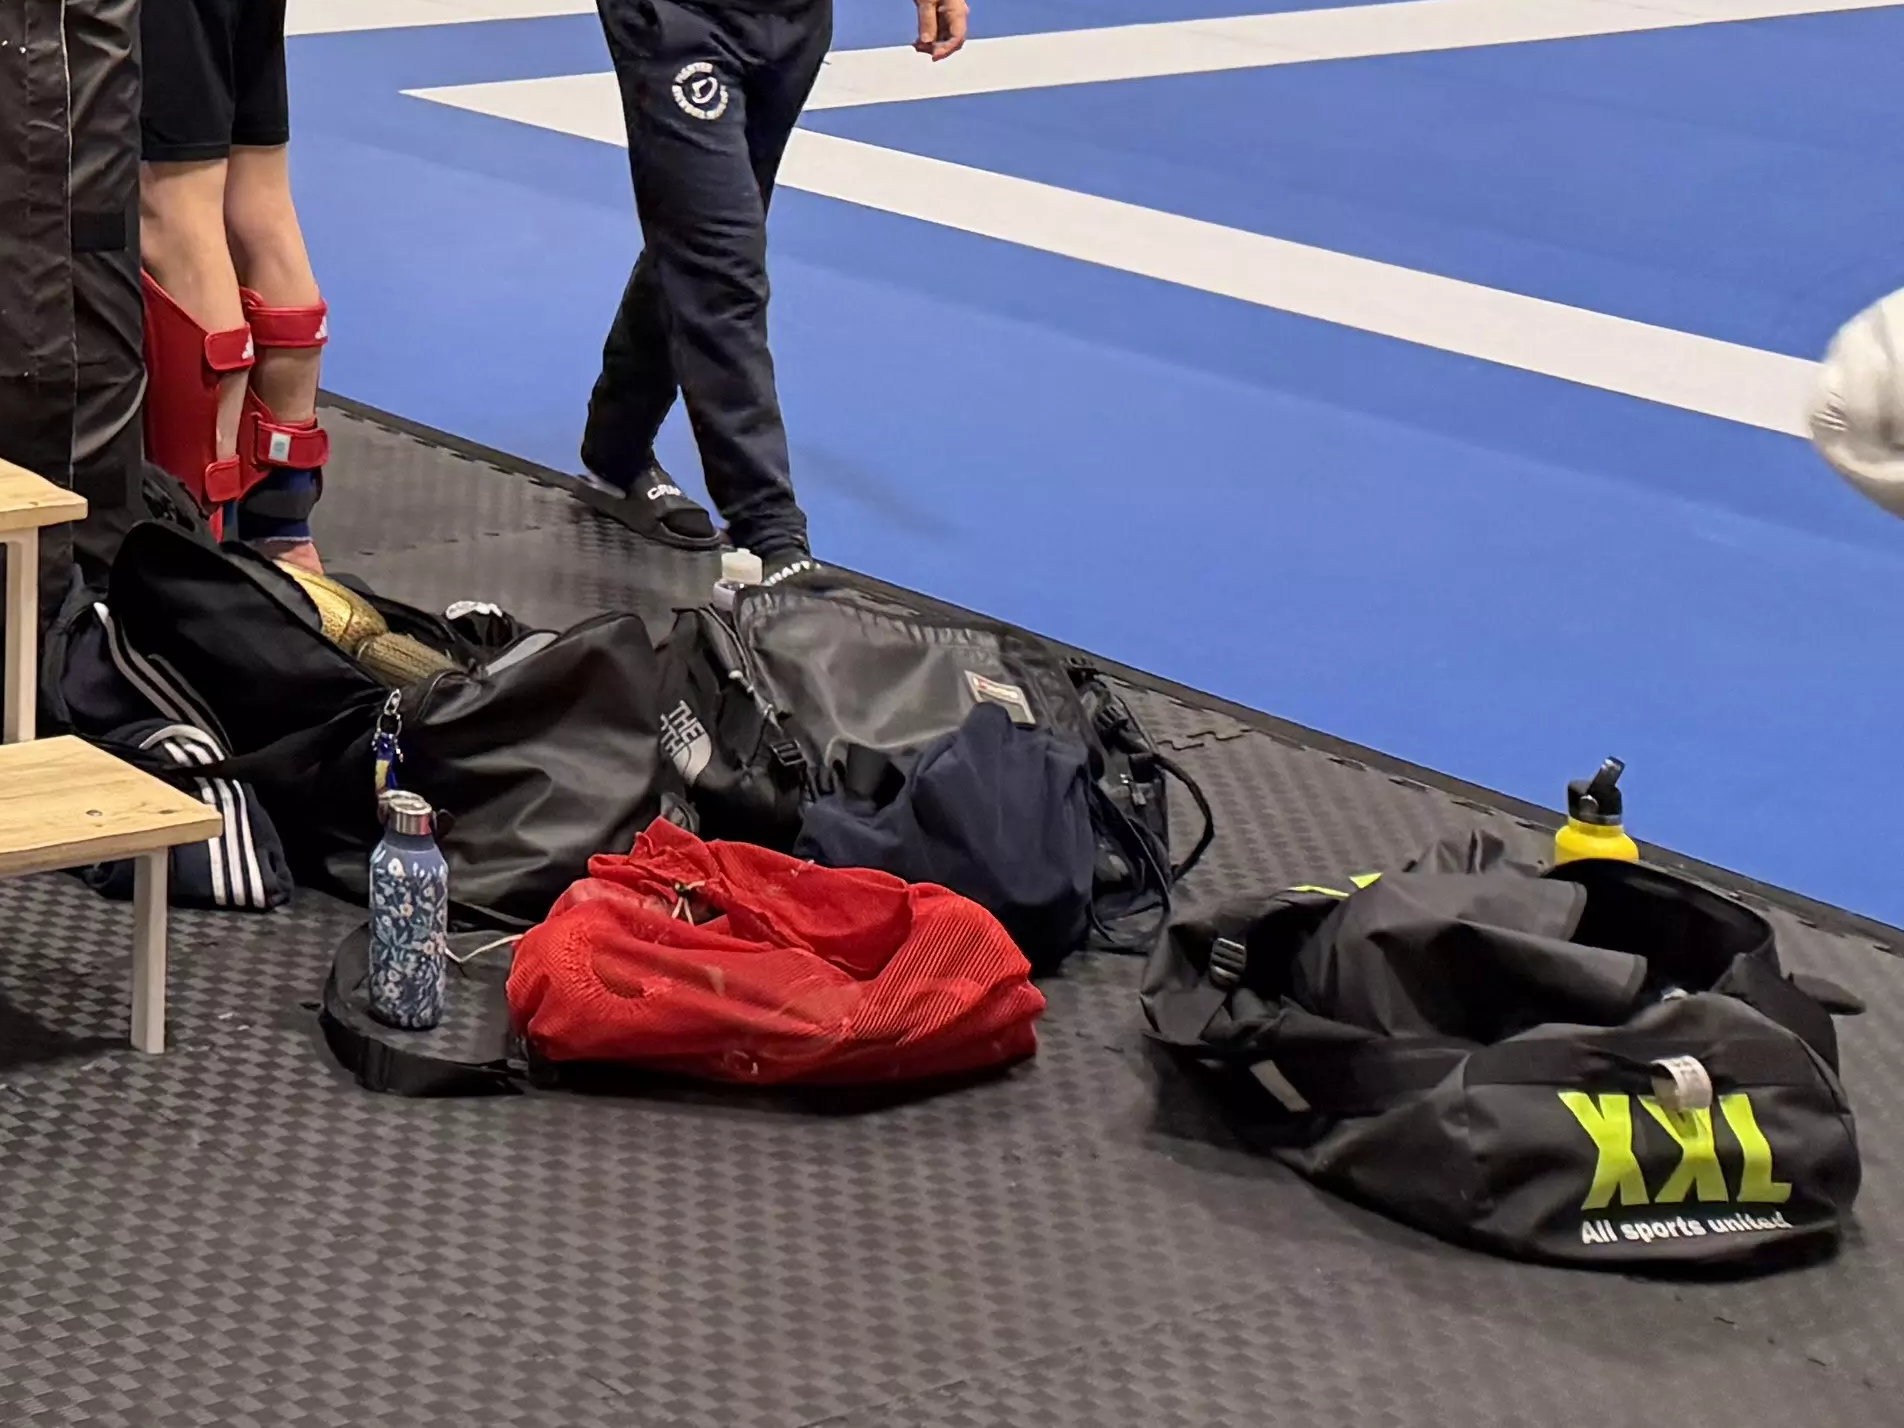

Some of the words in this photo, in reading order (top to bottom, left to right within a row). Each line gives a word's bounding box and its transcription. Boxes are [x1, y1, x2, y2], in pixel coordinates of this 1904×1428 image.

[668, 699, 706, 744] THE
[1557, 1091, 1793, 1211] XXL
[1581, 1217, 1618, 1245] All
[1620, 1215, 1707, 1244] sports
[1707, 1210, 1794, 1233] united
